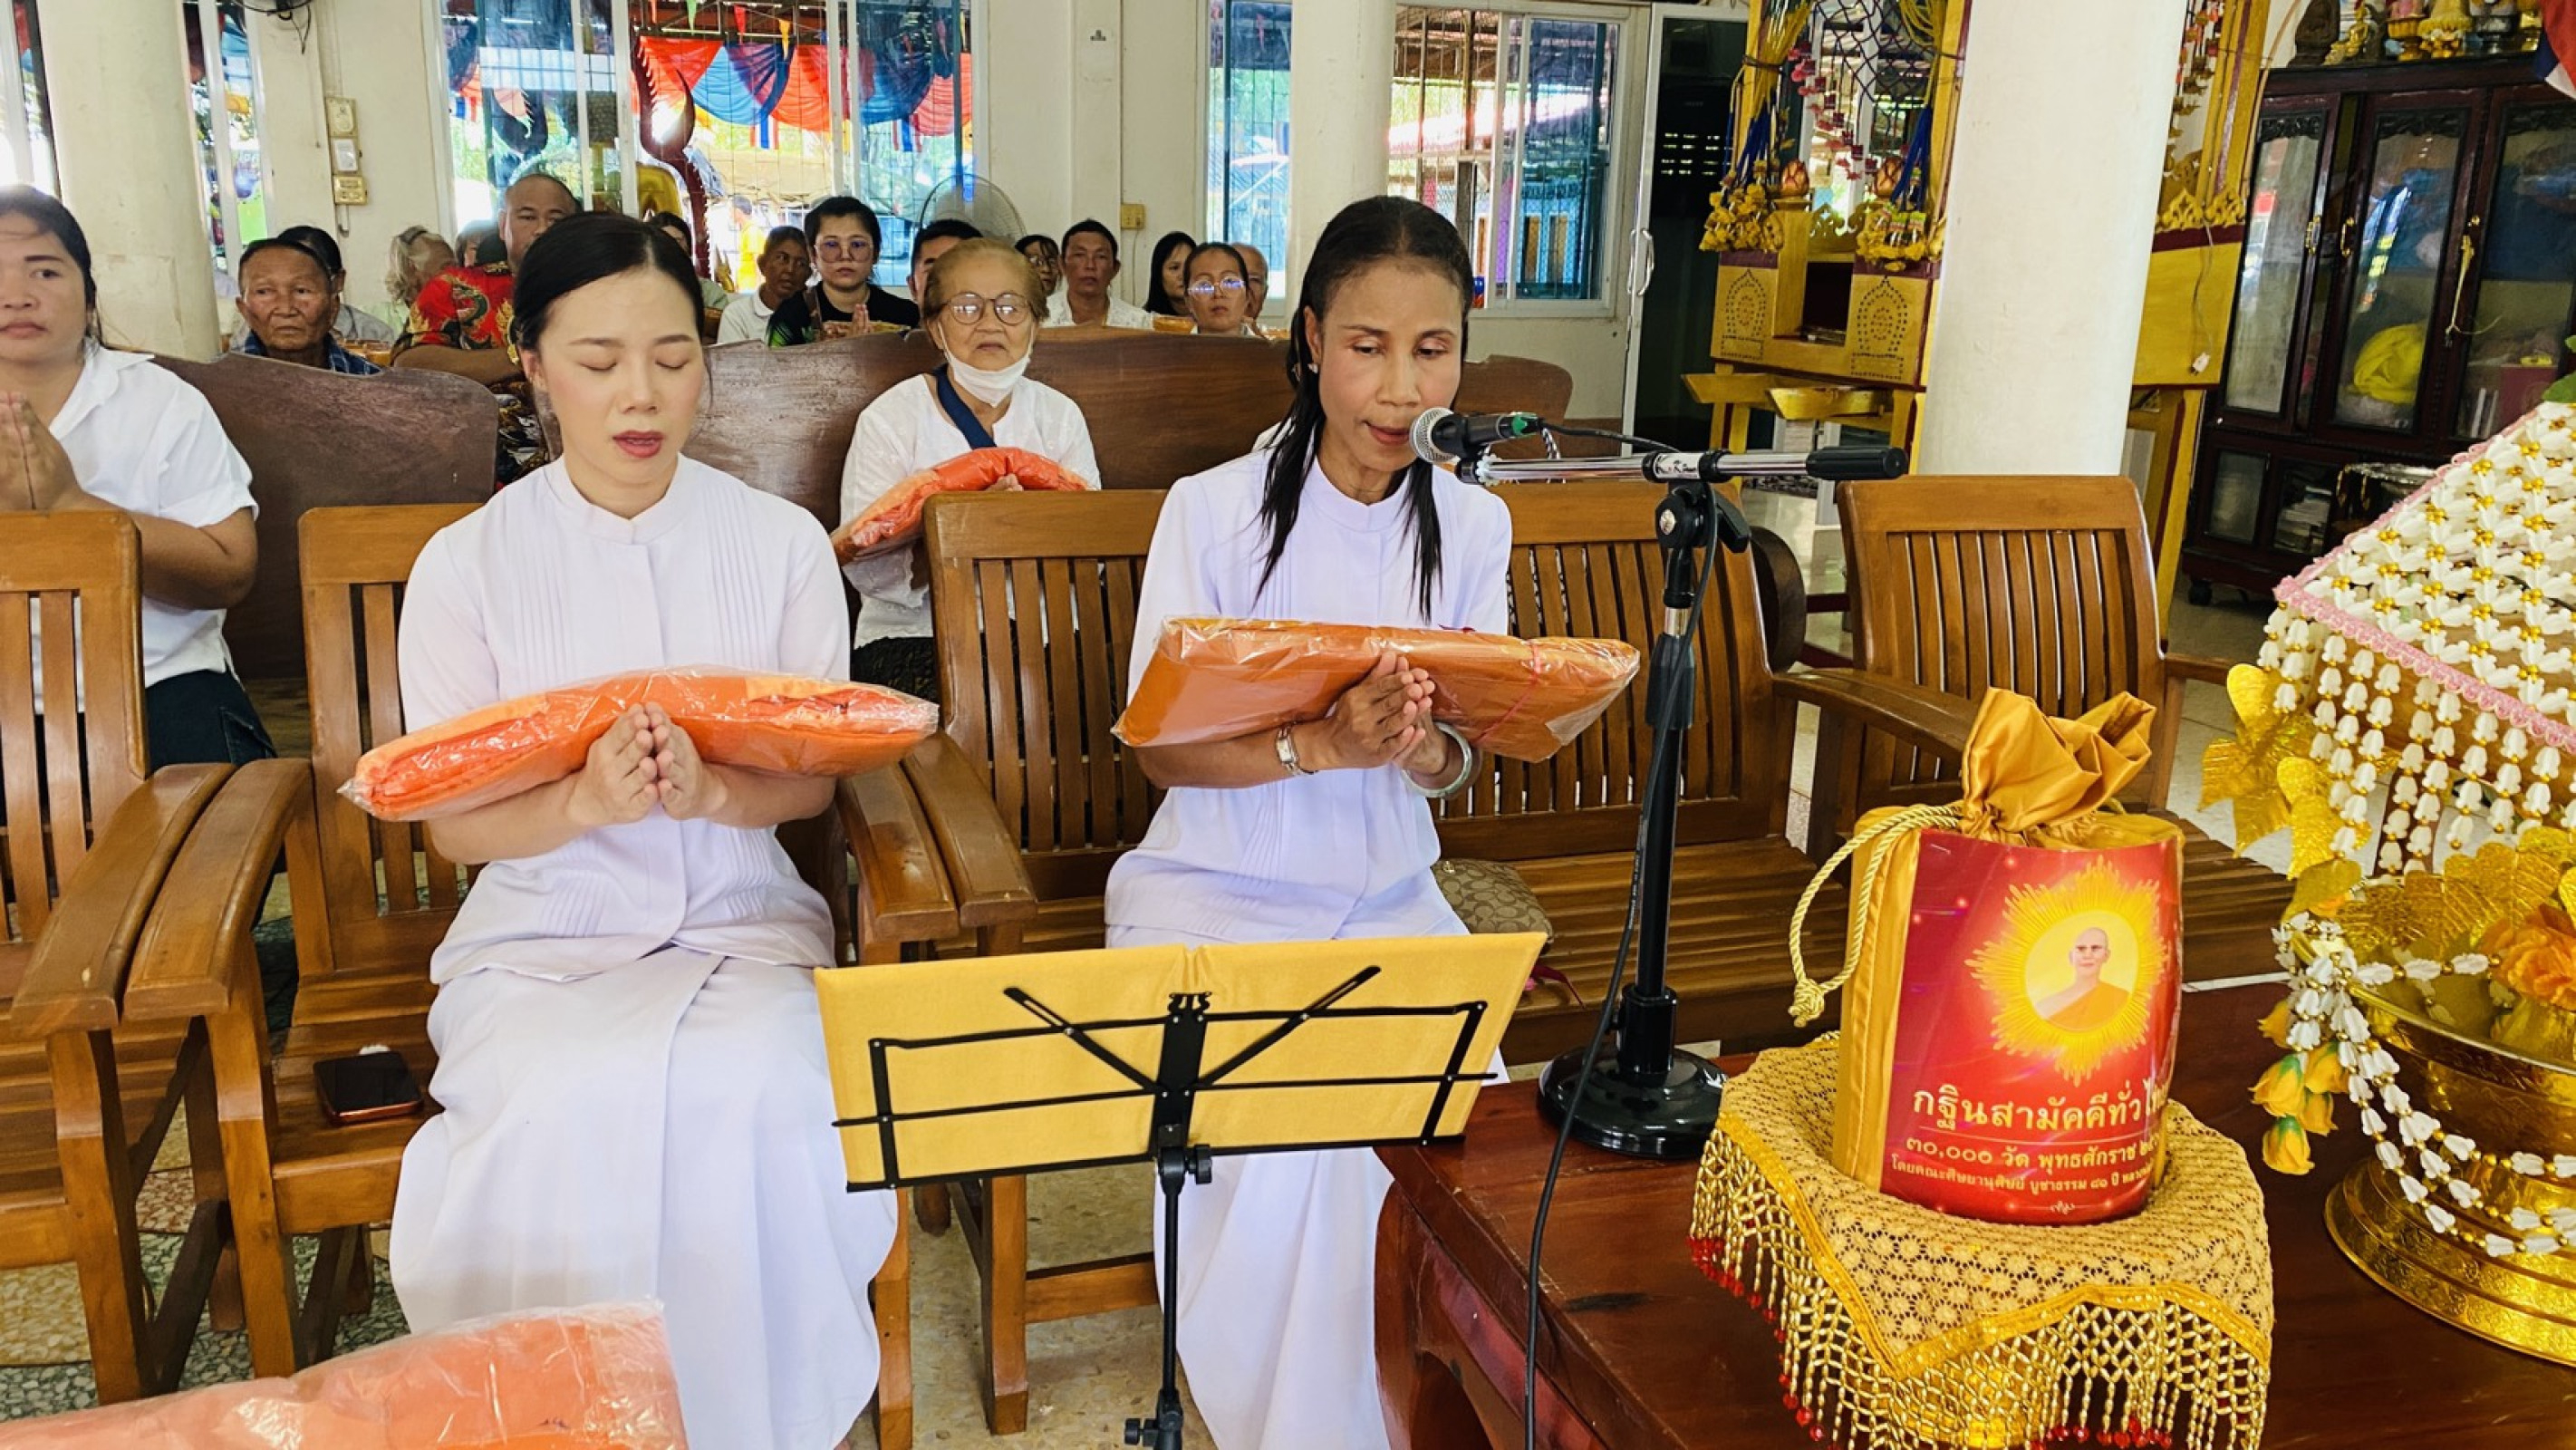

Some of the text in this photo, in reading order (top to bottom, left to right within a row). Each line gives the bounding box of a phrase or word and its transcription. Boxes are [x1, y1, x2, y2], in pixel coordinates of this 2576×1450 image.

[2001, 1146, 2031, 1168] วัด
[2038, 1142, 2137, 1175] พุทธศักราช
